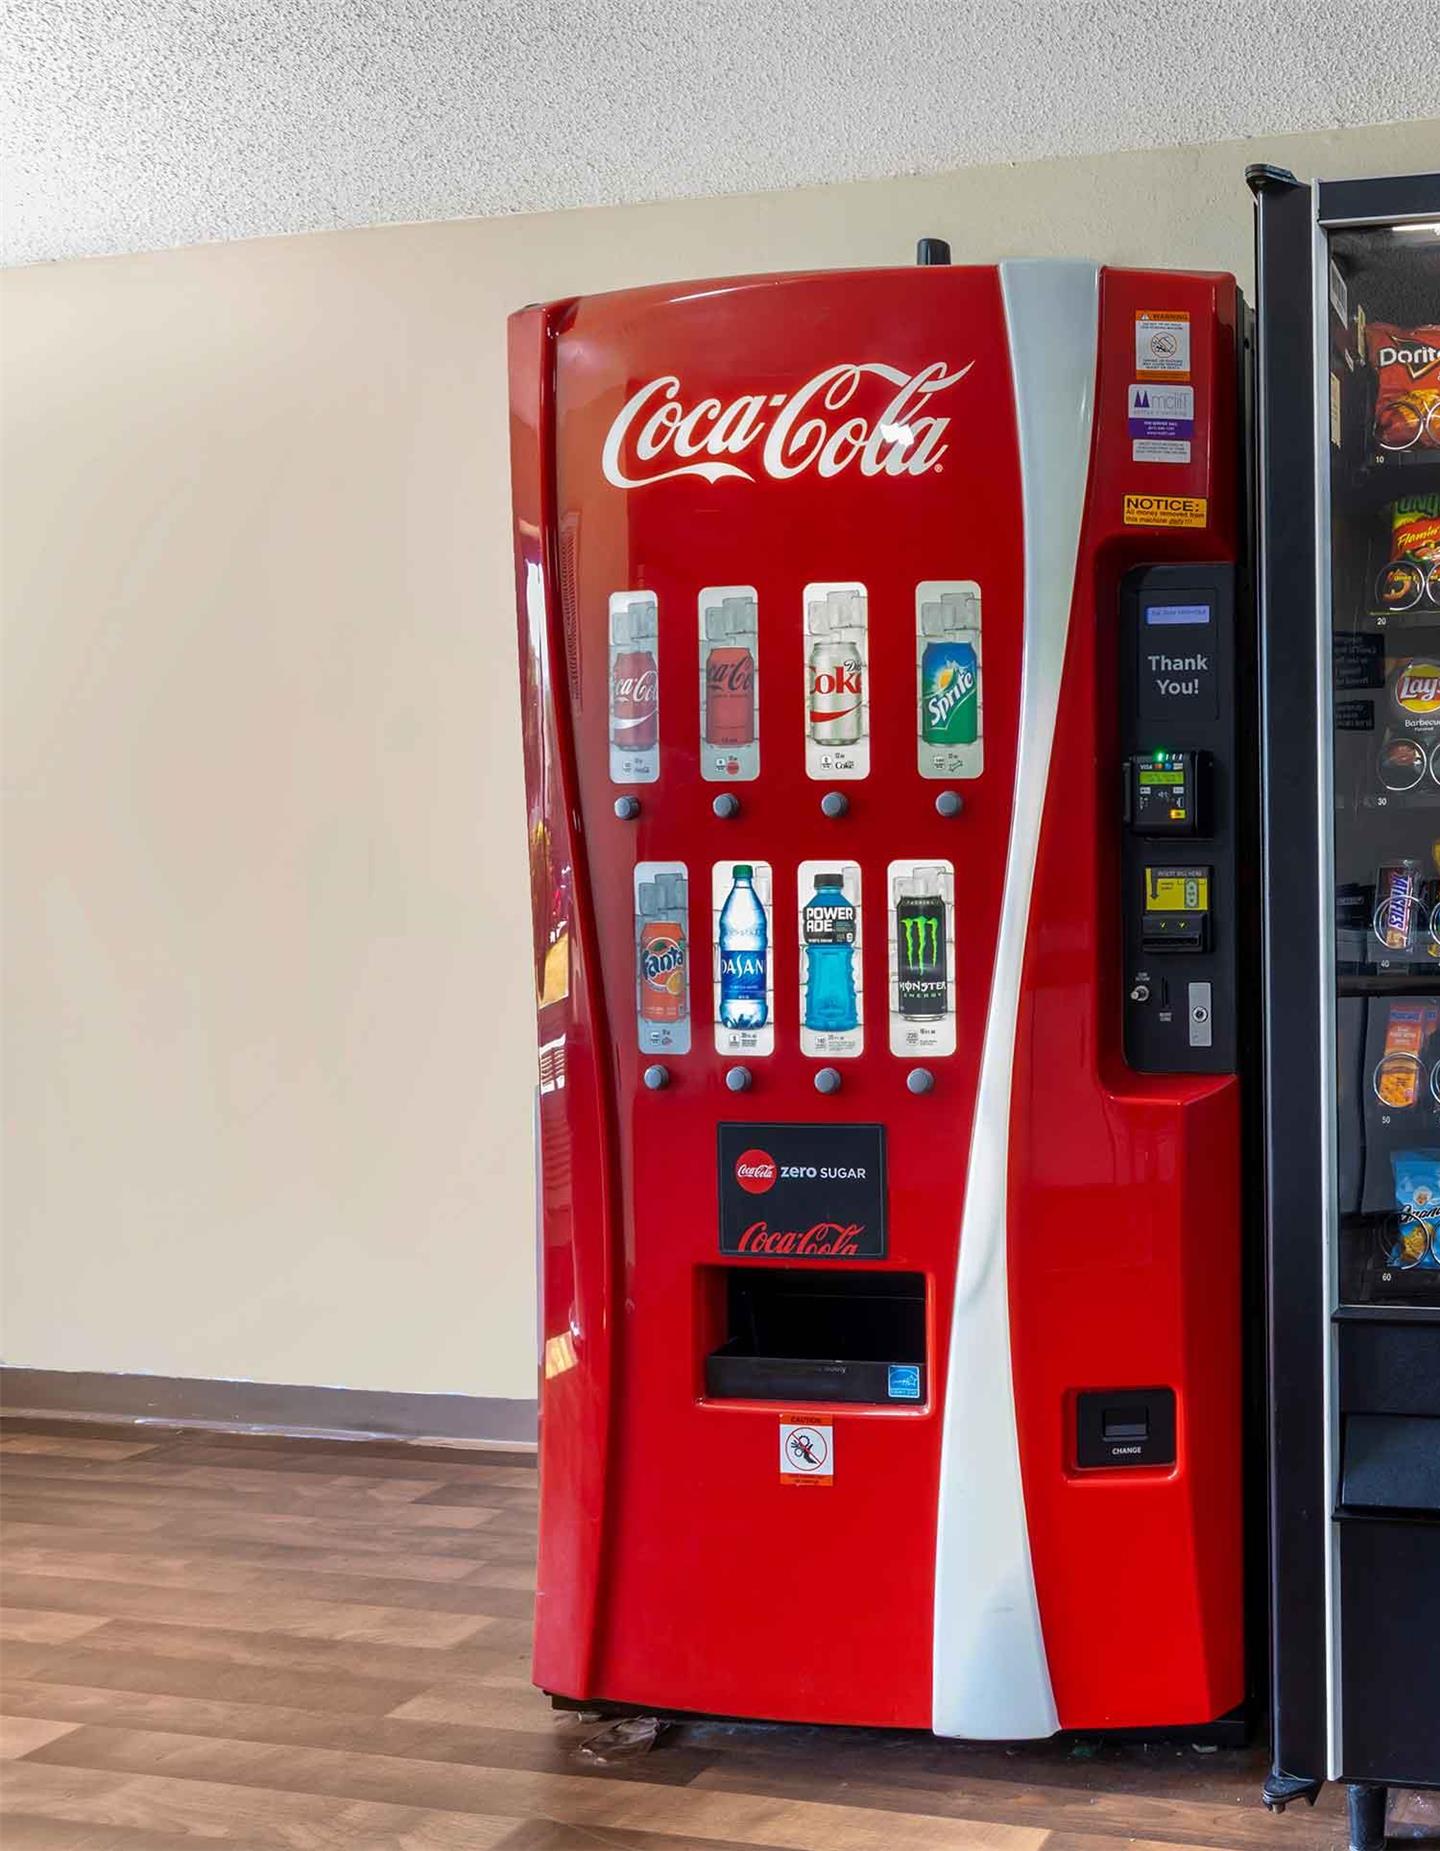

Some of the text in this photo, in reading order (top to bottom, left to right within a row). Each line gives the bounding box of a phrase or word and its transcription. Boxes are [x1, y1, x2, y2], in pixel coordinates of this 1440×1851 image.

[602, 361, 975, 488] Coca-Cola
[1126, 498, 1200, 512] NOTICE:
[1376, 617, 1386, 625] 20
[1148, 654, 1208, 671] Thank
[1156, 678, 1198, 694] You!
[928, 669, 974, 726] Sprite
[1378, 798, 1387, 806] 30
[806, 906, 853, 920] POWER
[806, 920, 832, 932] ADE
[1380, 960, 1390, 968] 40
[900, 981, 946, 992] MONSTER
[1382, 1116, 1390, 1124] 50
[737, 1164, 866, 1179] Coca-Cola zero SUGAR
[738, 1220, 865, 1256] Coca-Cola
[1382, 1272, 1392, 1281] 60
[790, 1416, 822, 1424] CAUTION
[1112, 1446, 1142, 1455] CHANGE
